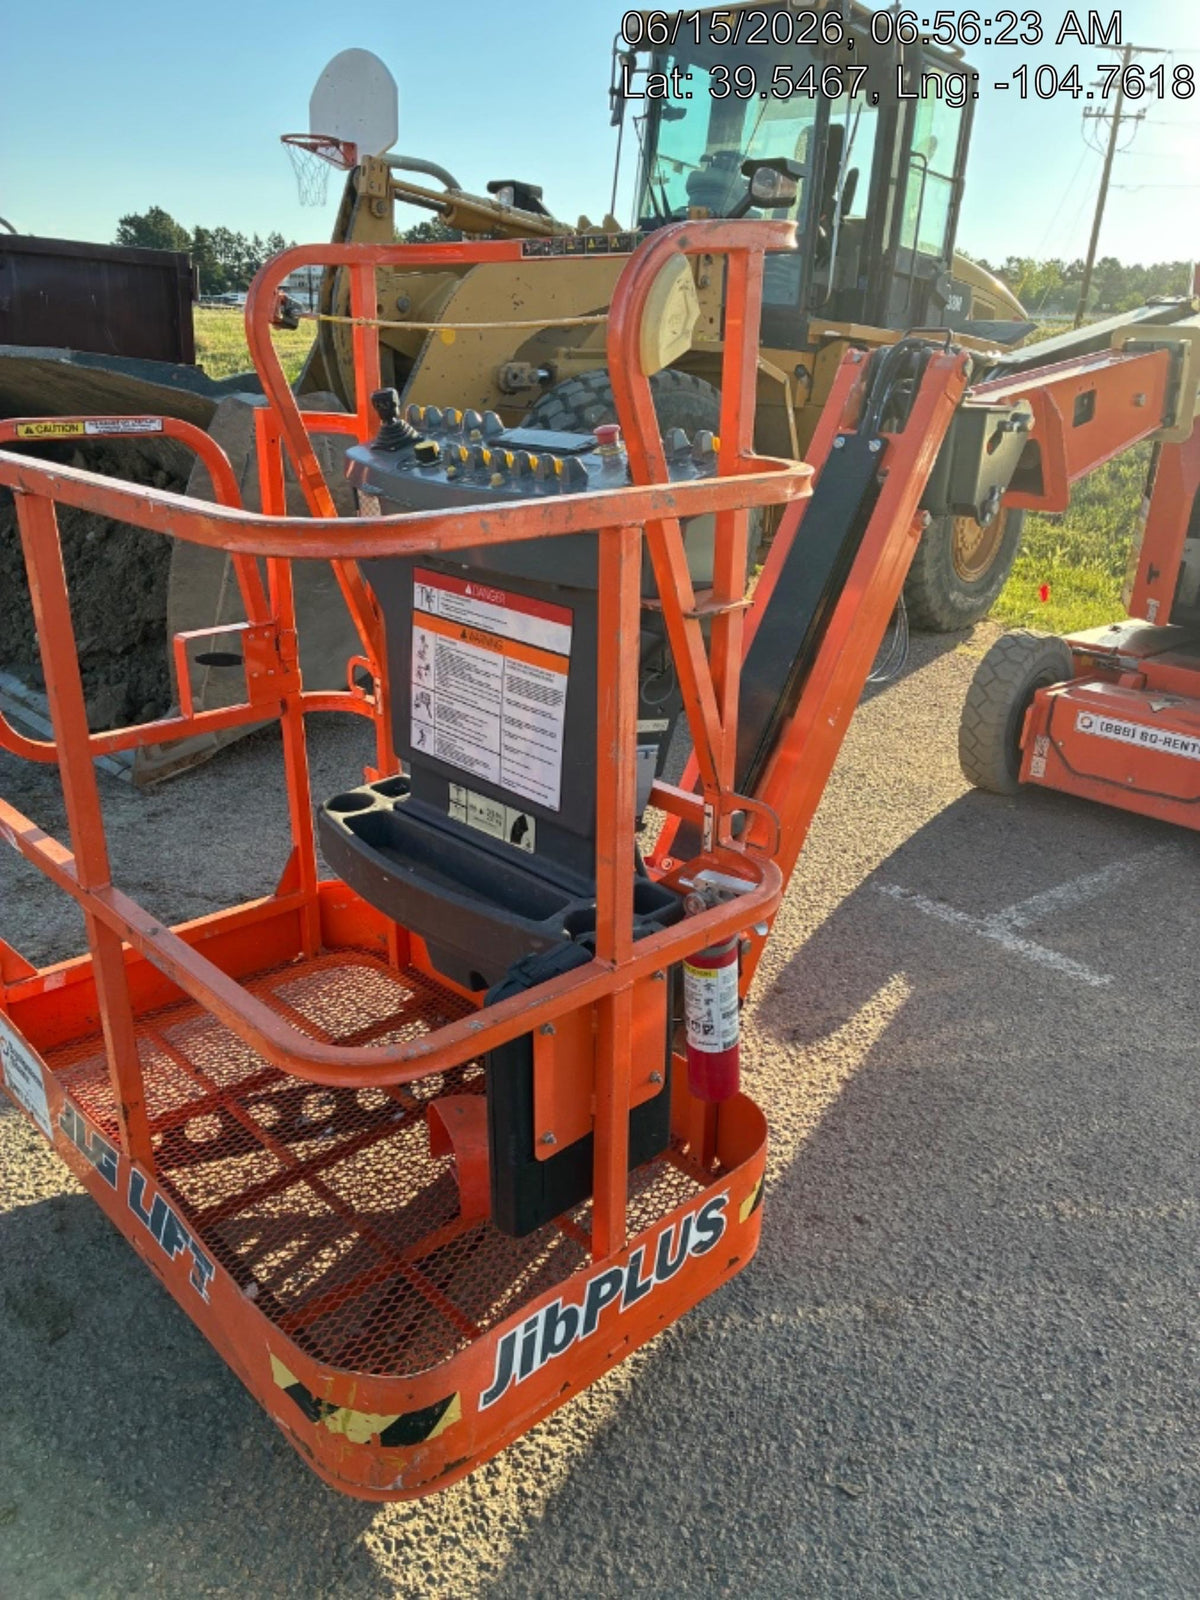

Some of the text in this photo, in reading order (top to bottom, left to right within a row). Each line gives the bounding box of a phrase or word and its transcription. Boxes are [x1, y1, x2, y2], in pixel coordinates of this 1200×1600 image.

[36, 423, 79, 434] CAUTION
[472, 585, 506, 605] DANGER
[469, 629, 503, 651] WARNING
[1100, 721, 1136, 739] (888)
[58, 1097, 215, 1304] JLG LIFT
[478, 1190, 729, 1412] JibPLUS
